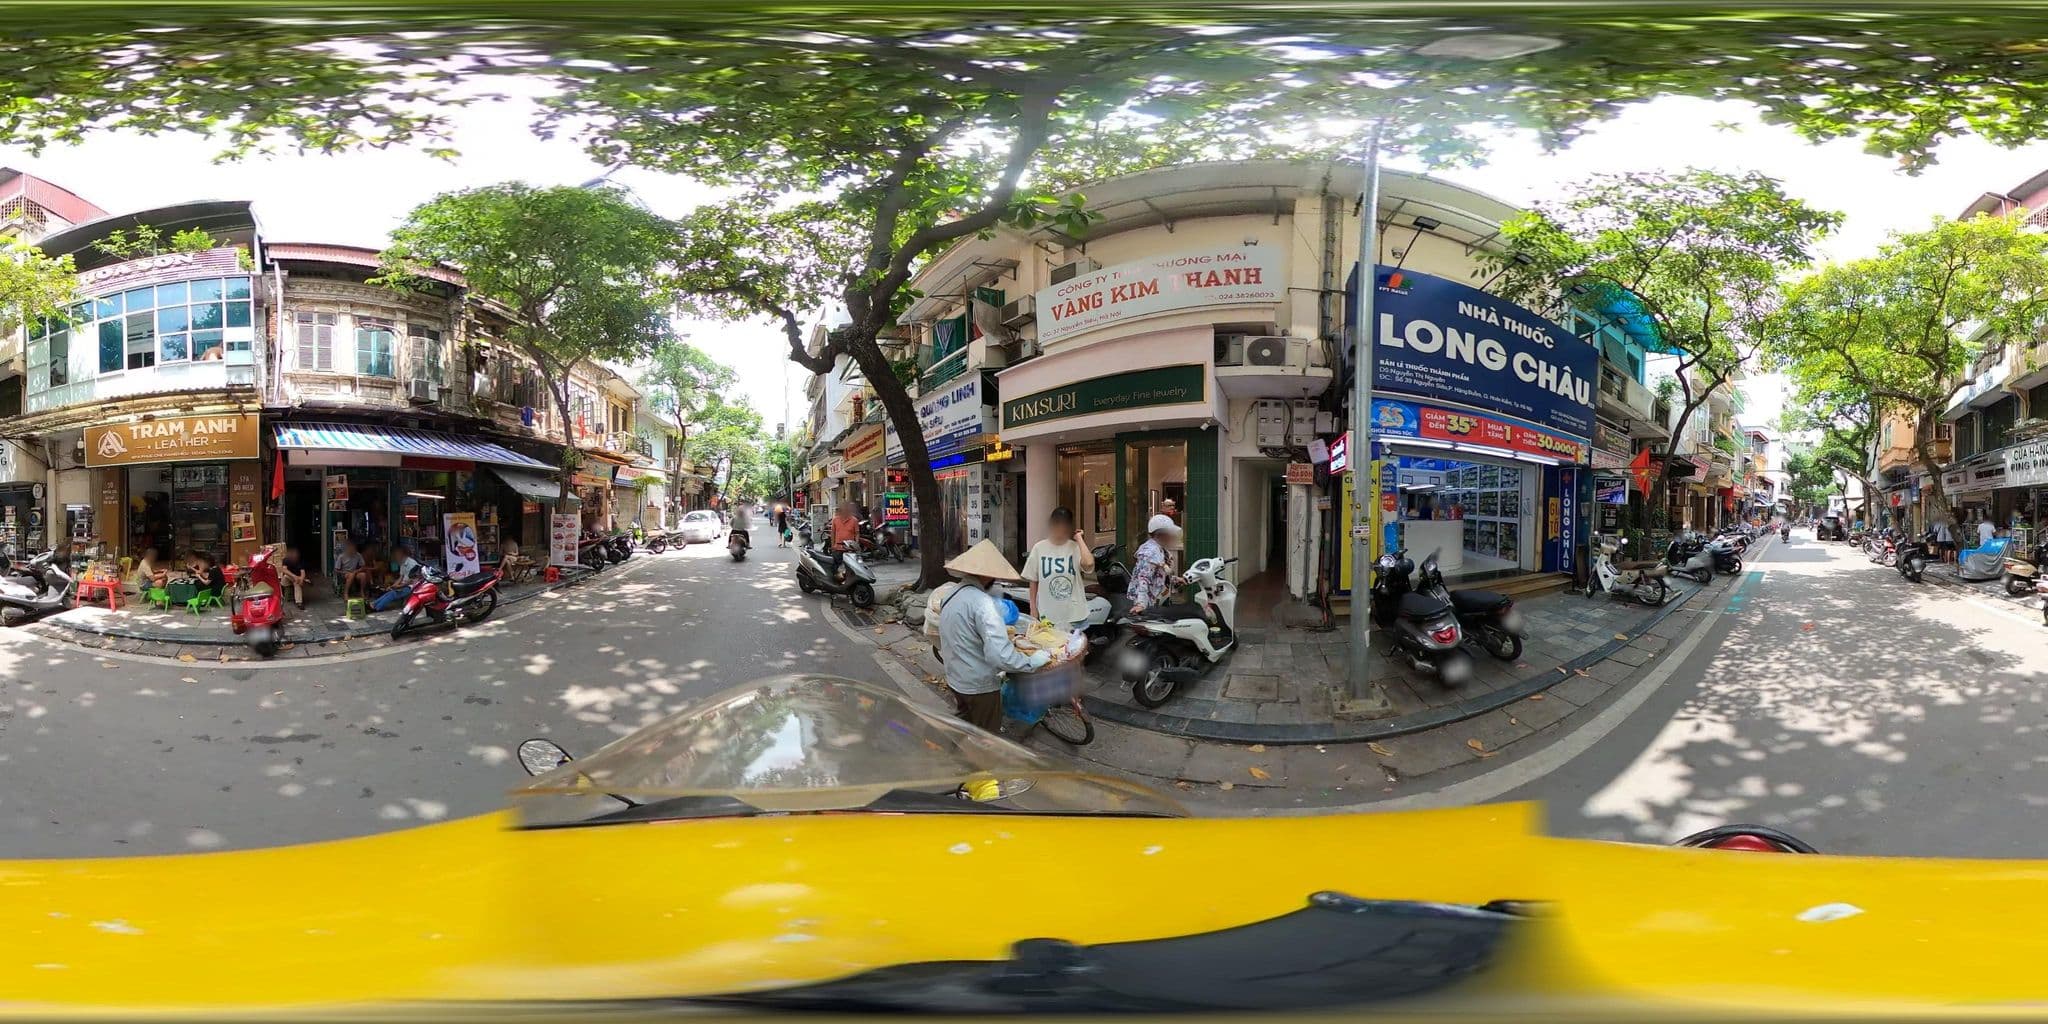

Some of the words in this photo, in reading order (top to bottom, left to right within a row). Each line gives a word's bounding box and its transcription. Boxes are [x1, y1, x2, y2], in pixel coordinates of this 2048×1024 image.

[1051, 291, 1103, 321] VÀNG
[1111, 278, 1160, 304] KIM
[1168, 267, 1262, 291] THANH
[1057, 280, 1092, 297] CÔNG
[1095, 275, 1108, 284] TY
[1459, 301, 1500, 327] NHÀ
[1503, 316, 1554, 349] THUỐC
[1380, 313, 1507, 371] LONG
[1513, 352, 1590, 406] CHÂU
[1405, 363, 1429, 372] THUỐC
[921, 394, 950, 418] QUANG
[951, 382, 975, 404] LINH
[1012, 391, 1077, 422] KIMSURI
[1093, 394, 1131, 406] Everyday
[1133, 391, 1151, 400] Fine
[1153, 387, 1188, 400] Jewelry
[129, 420, 185, 440] TRAM
[193, 419, 237, 434] ANH
[1428, 420, 1446, 429] ĐẾN
[1446, 414, 1478, 434] 35%
[1487, 423, 1504, 432] MUA
[1504, 425, 1511, 442] 1
[155, 437, 209, 450] LEATHER
[2010, 461, 2030, 473] PING
[886, 505, 908, 516] THUỐC
[889, 498, 904, 506] NHÀ
[1563, 488, 1571, 526] LONG
[1041, 555, 1076, 579] USA
